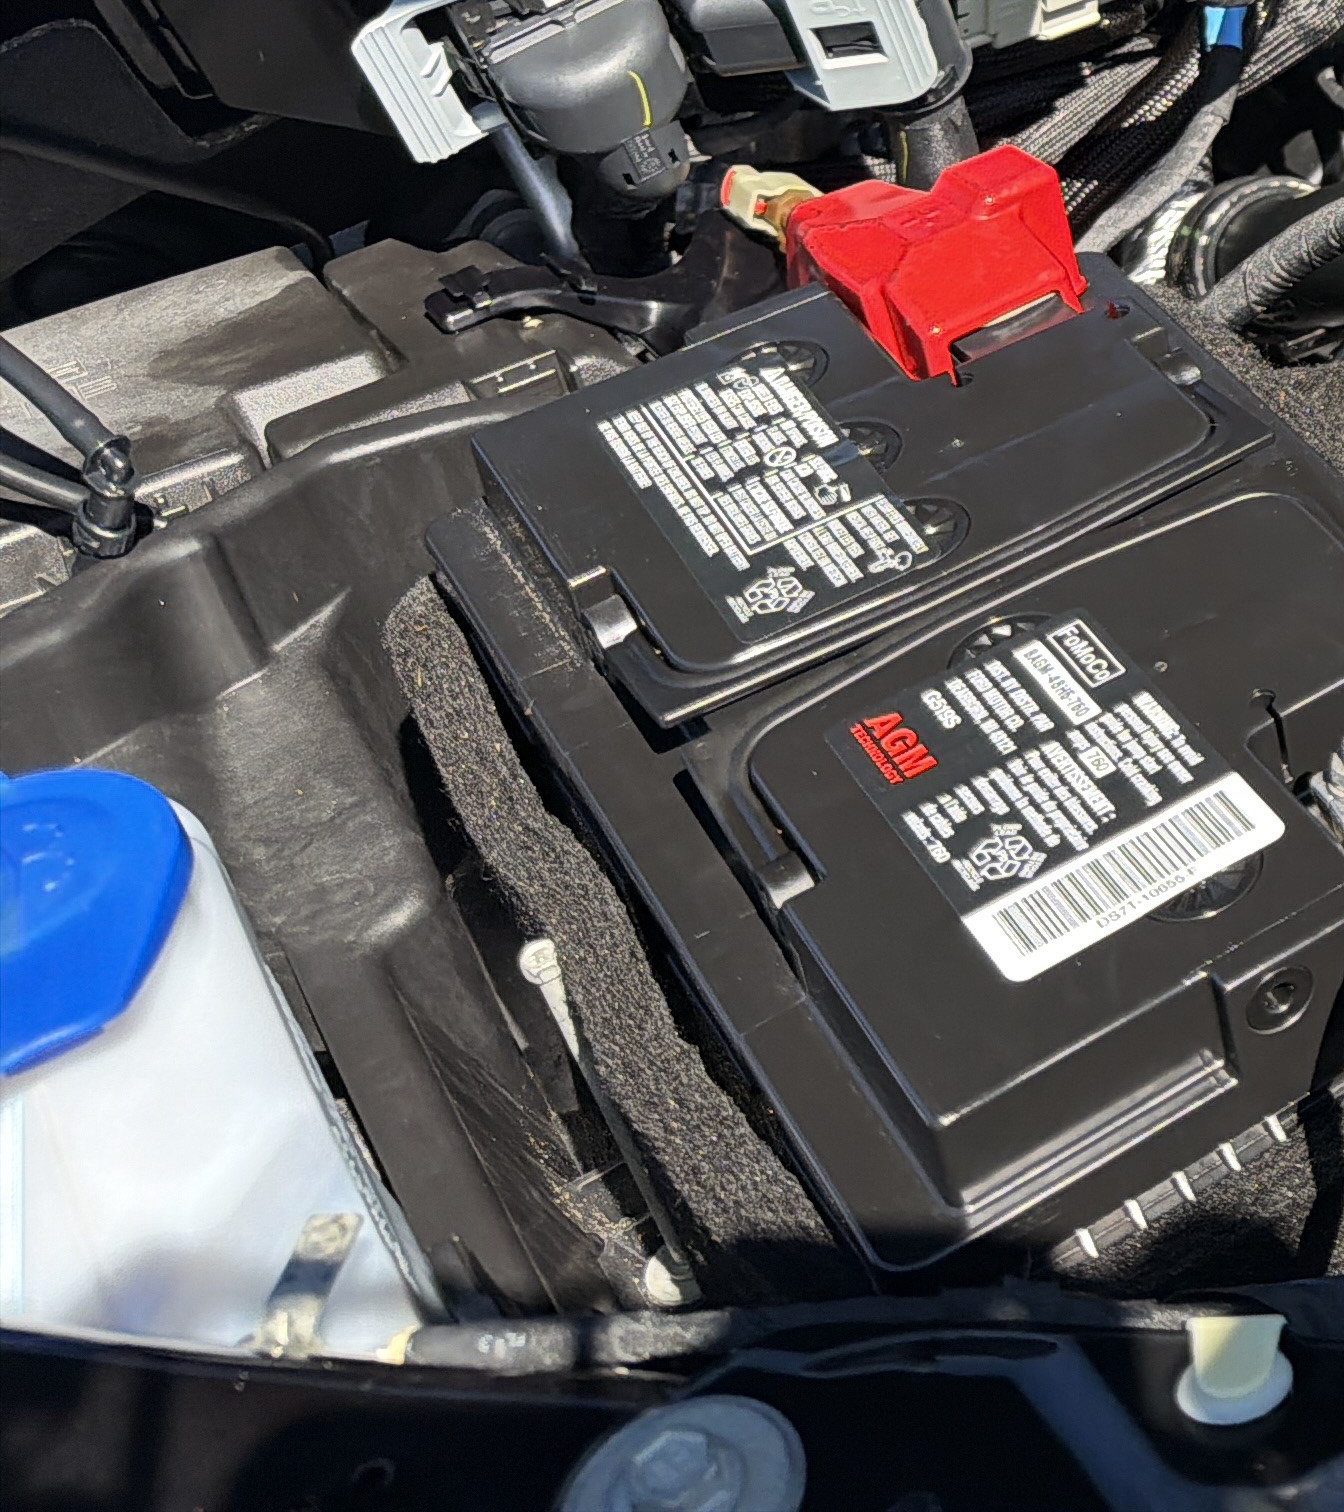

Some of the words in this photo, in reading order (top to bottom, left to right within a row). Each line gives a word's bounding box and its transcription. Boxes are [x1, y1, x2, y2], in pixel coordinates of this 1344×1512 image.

[1056, 626, 1113, 681] FoMoCo
[850, 724, 902, 783] TECHNOLOGY
[864, 713, 936, 777] AGM
[1087, 750, 1110, 772] 760
